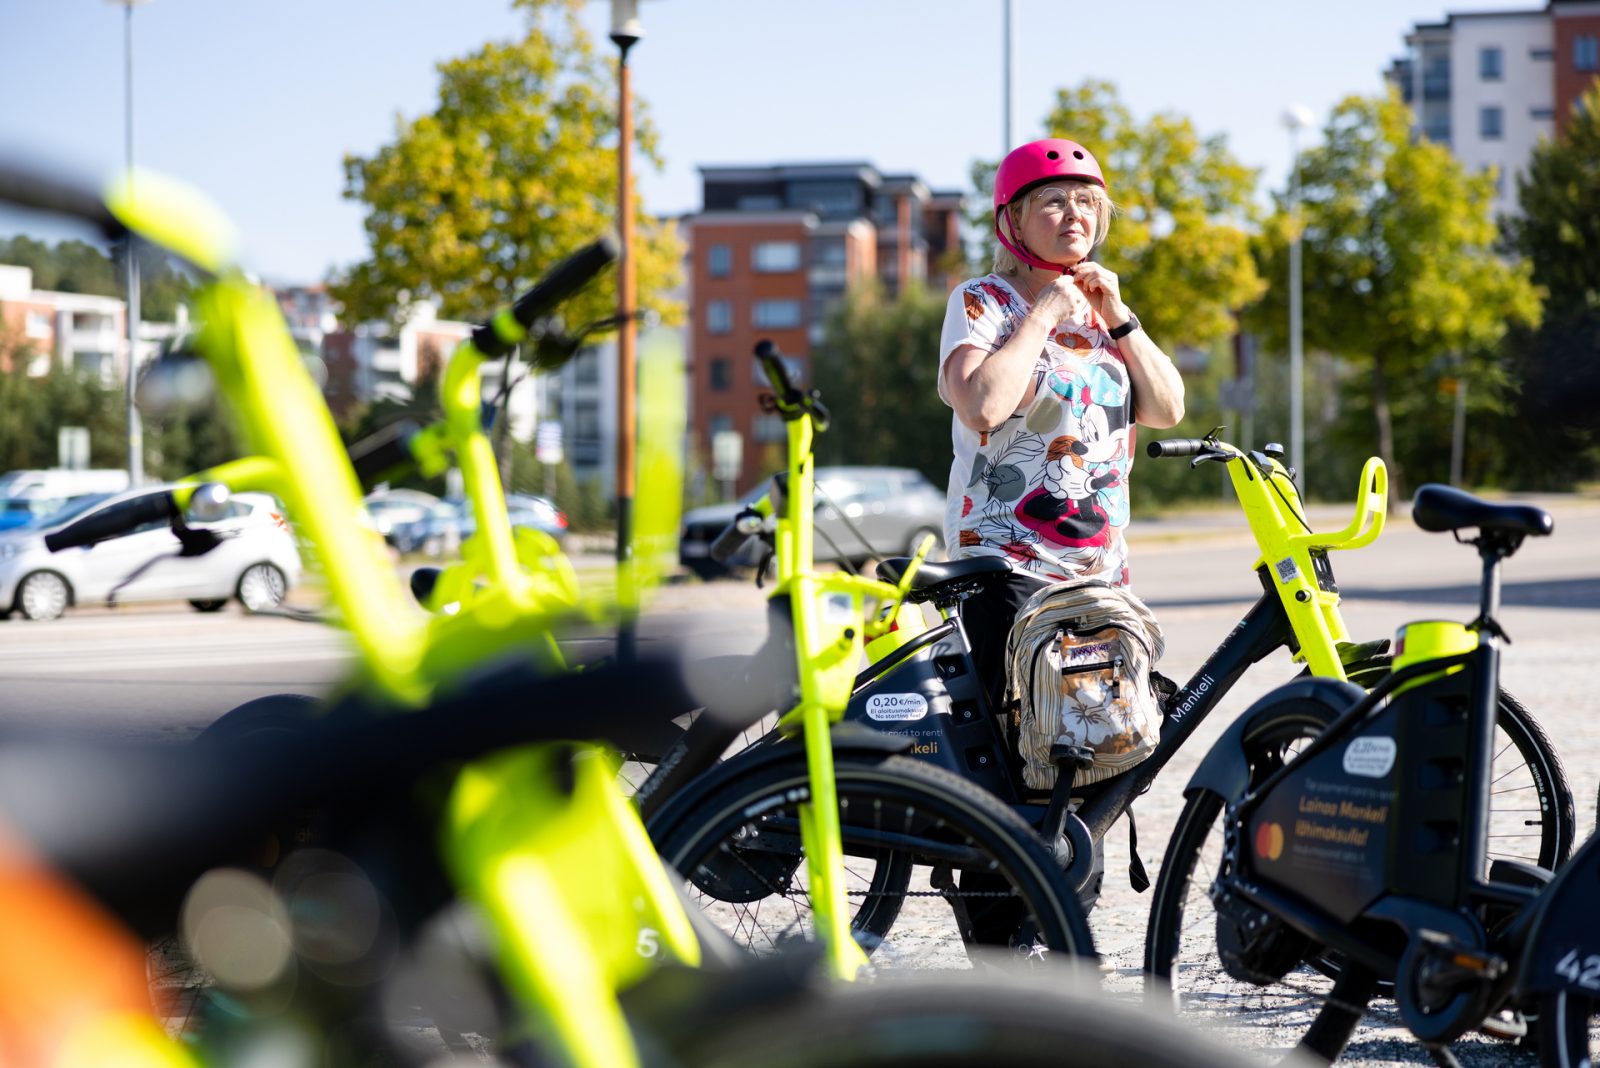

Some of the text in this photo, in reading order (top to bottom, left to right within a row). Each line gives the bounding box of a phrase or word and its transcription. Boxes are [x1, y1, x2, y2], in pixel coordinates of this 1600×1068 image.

[873, 697, 921, 707] 0,20 €/min
[1169, 673, 1215, 723] Mankeli
[910, 729, 920, 737] to
[922, 729, 944, 737] rent!
